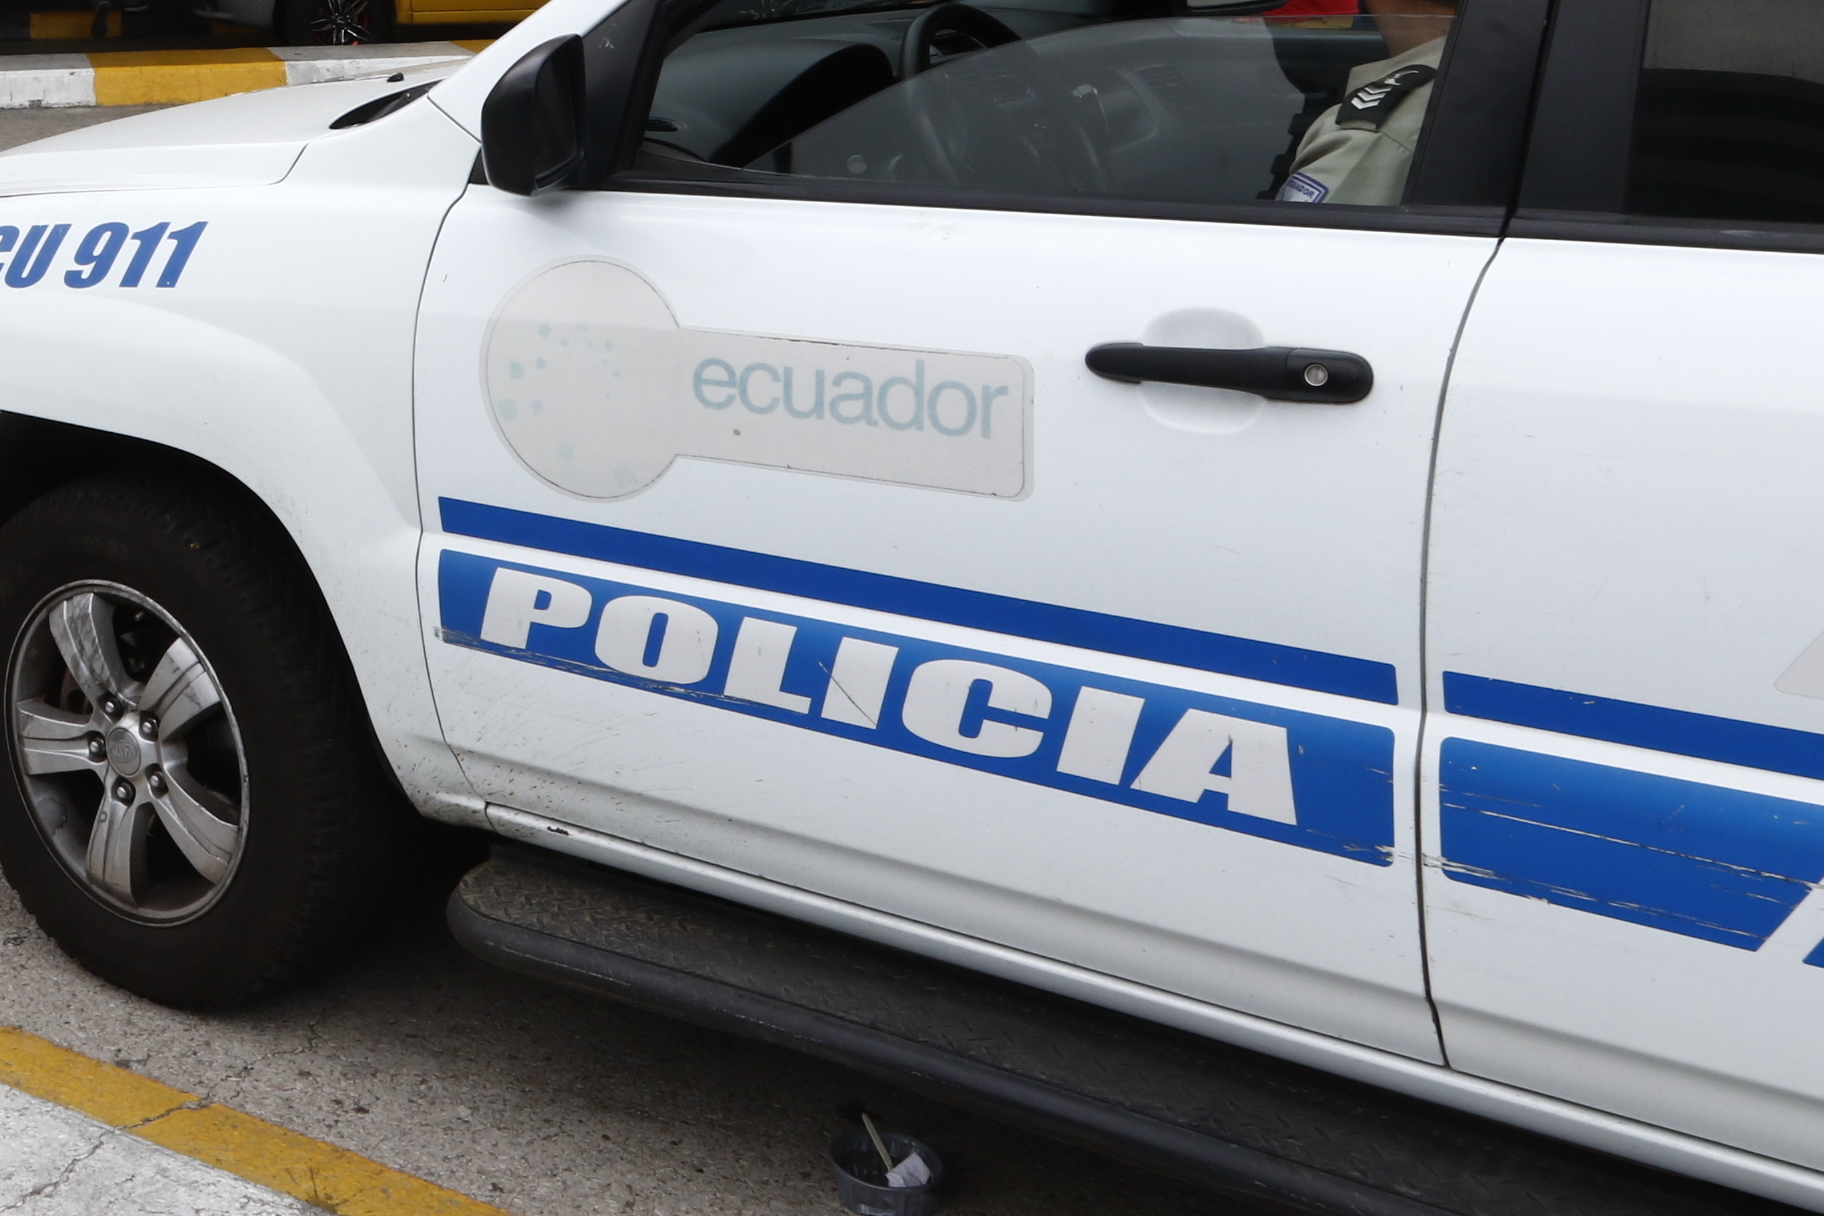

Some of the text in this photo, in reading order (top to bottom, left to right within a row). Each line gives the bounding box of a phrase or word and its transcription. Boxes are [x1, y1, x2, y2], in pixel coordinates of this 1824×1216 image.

[63, 221, 209, 289] 911
[692, 357, 1009, 440] ecuador
[480, 566, 1297, 826] POLICIA
